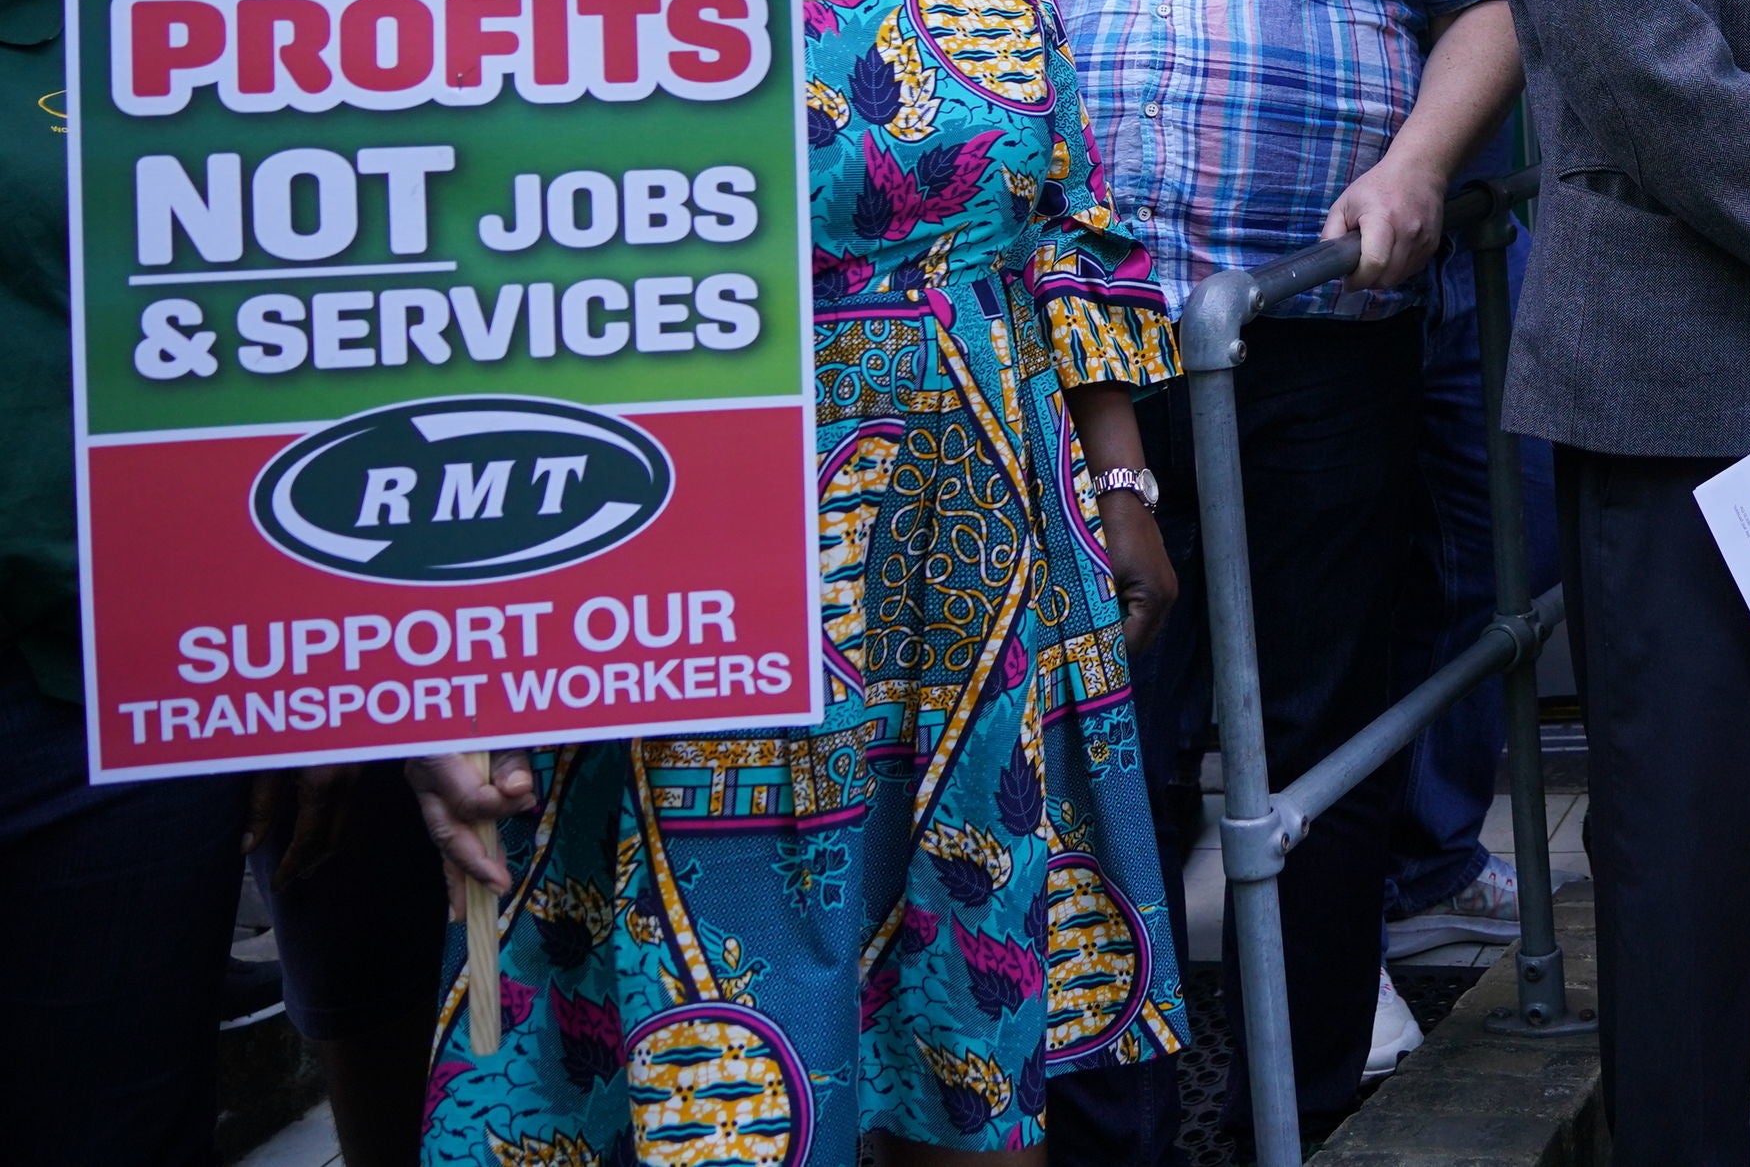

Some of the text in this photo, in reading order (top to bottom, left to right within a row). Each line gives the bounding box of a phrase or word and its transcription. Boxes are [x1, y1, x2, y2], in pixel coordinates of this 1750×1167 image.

[135, 145, 758, 266] NOT JOBS
[133, 273, 761, 380] & SERVICES
[355, 452, 589, 528] RMT
[177, 589, 736, 683] SUPPORT OUR
[119, 651, 790, 744] TRANSPORT WORKERS
